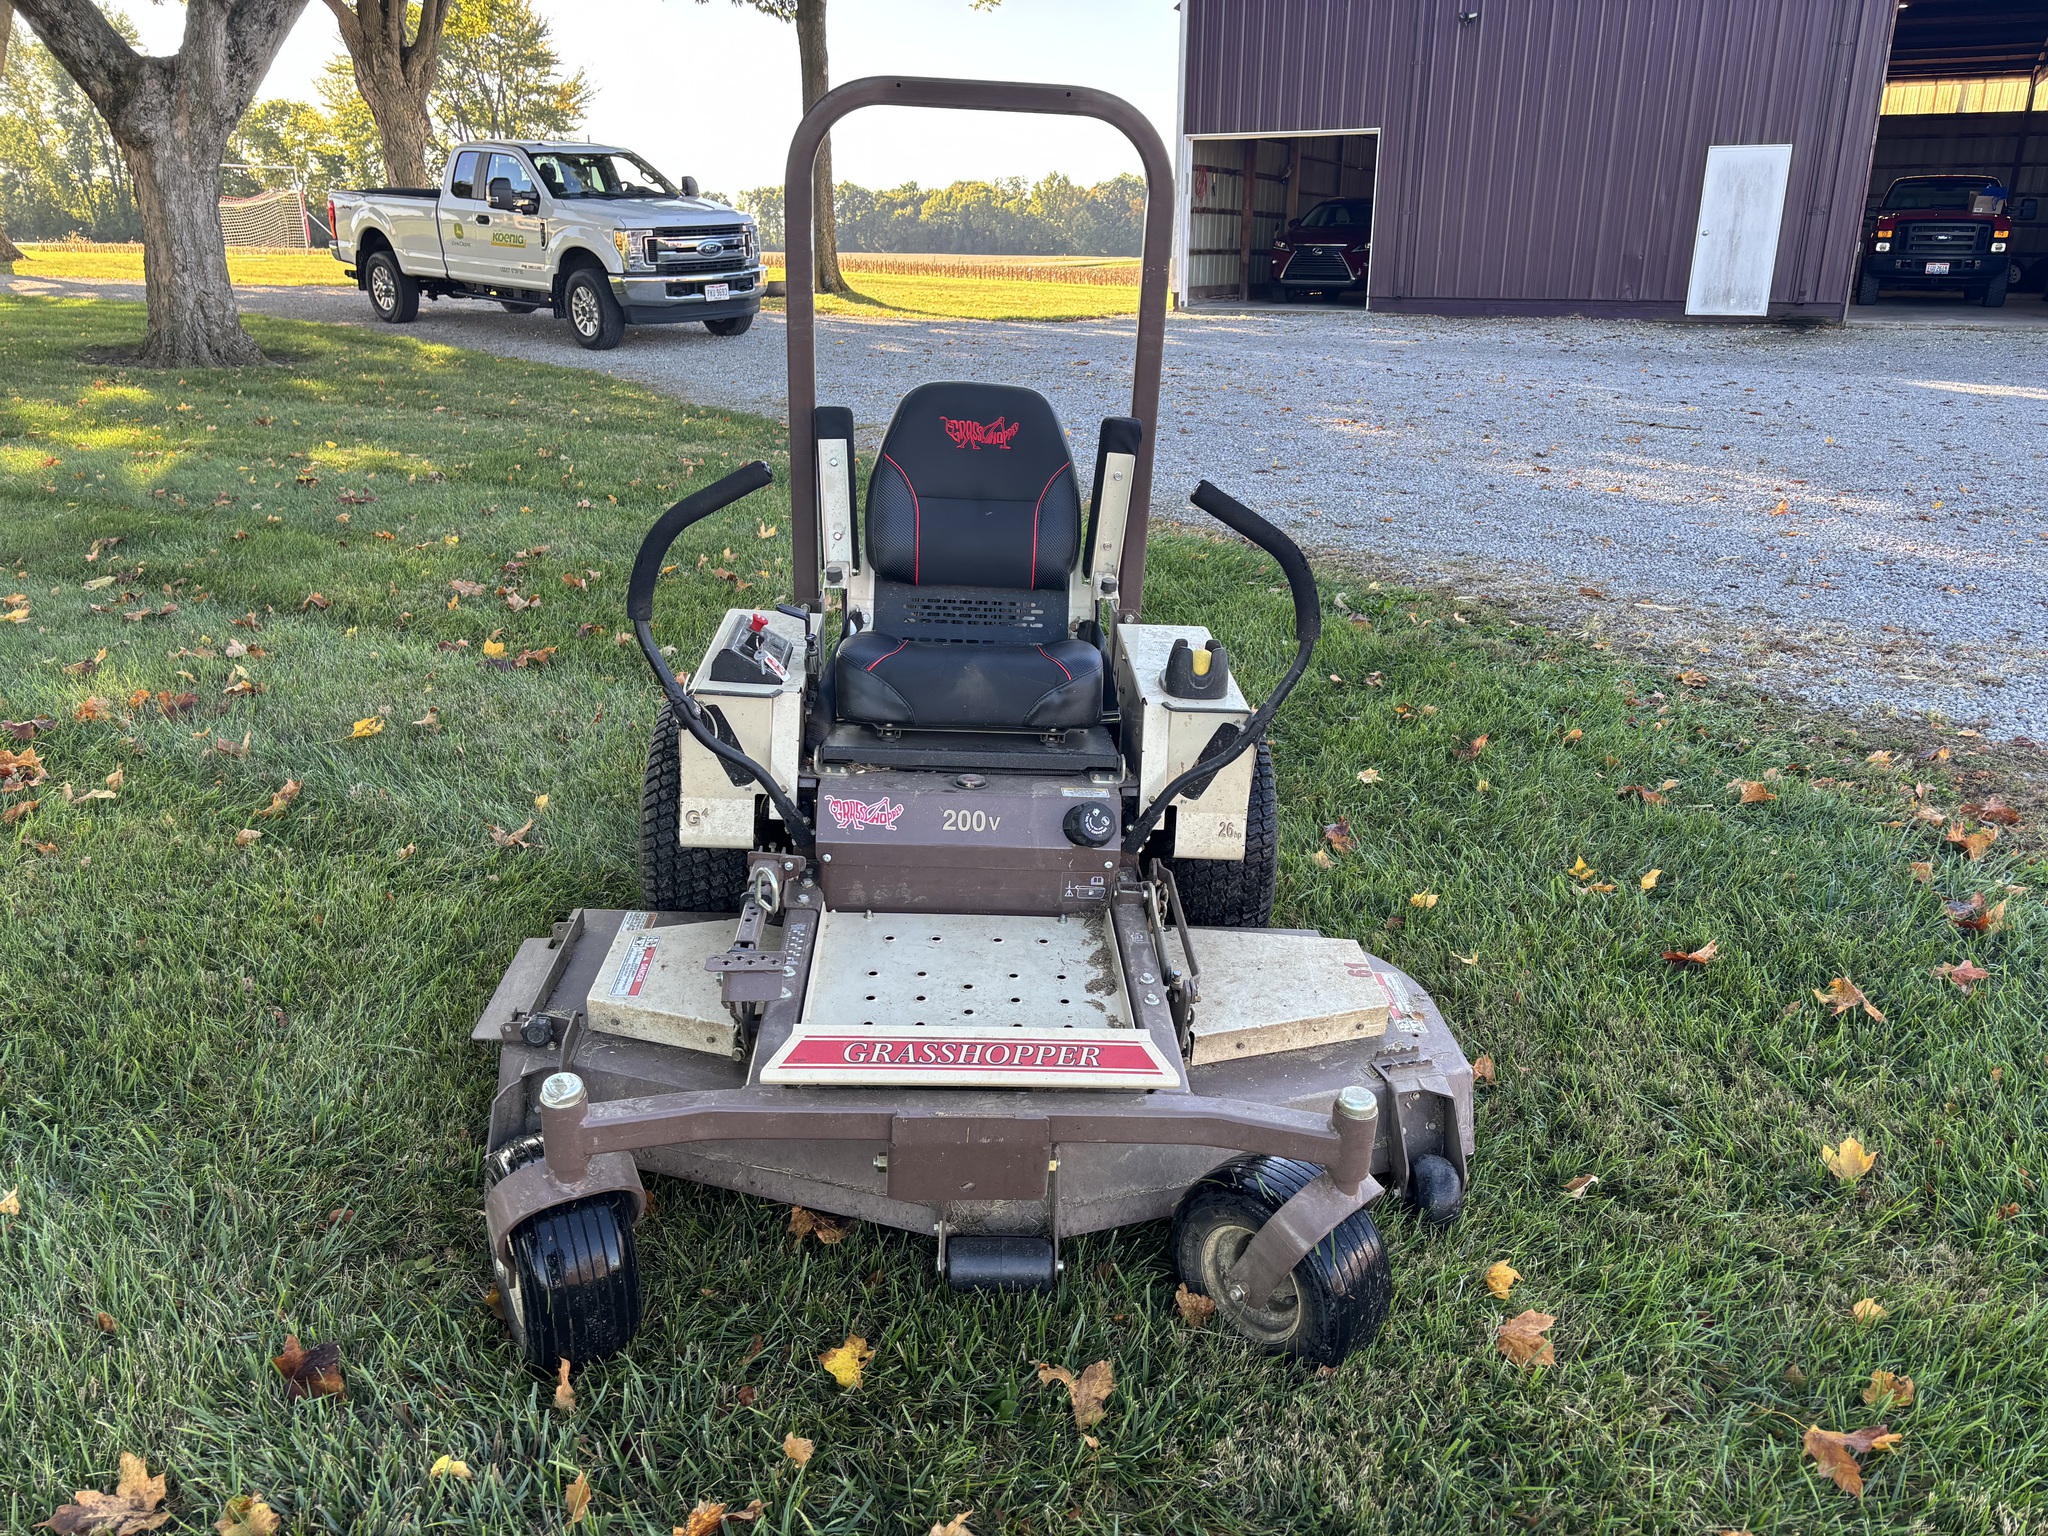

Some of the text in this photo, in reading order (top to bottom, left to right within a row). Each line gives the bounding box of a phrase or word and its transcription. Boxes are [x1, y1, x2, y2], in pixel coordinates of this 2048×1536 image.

[942, 417, 1019, 448] GRASSHOPPER
[827, 797, 903, 829] GRASSHOPPER
[1344, 962, 1373, 978] 61
[842, 1042, 1101, 1068] GRASSHOPPER
